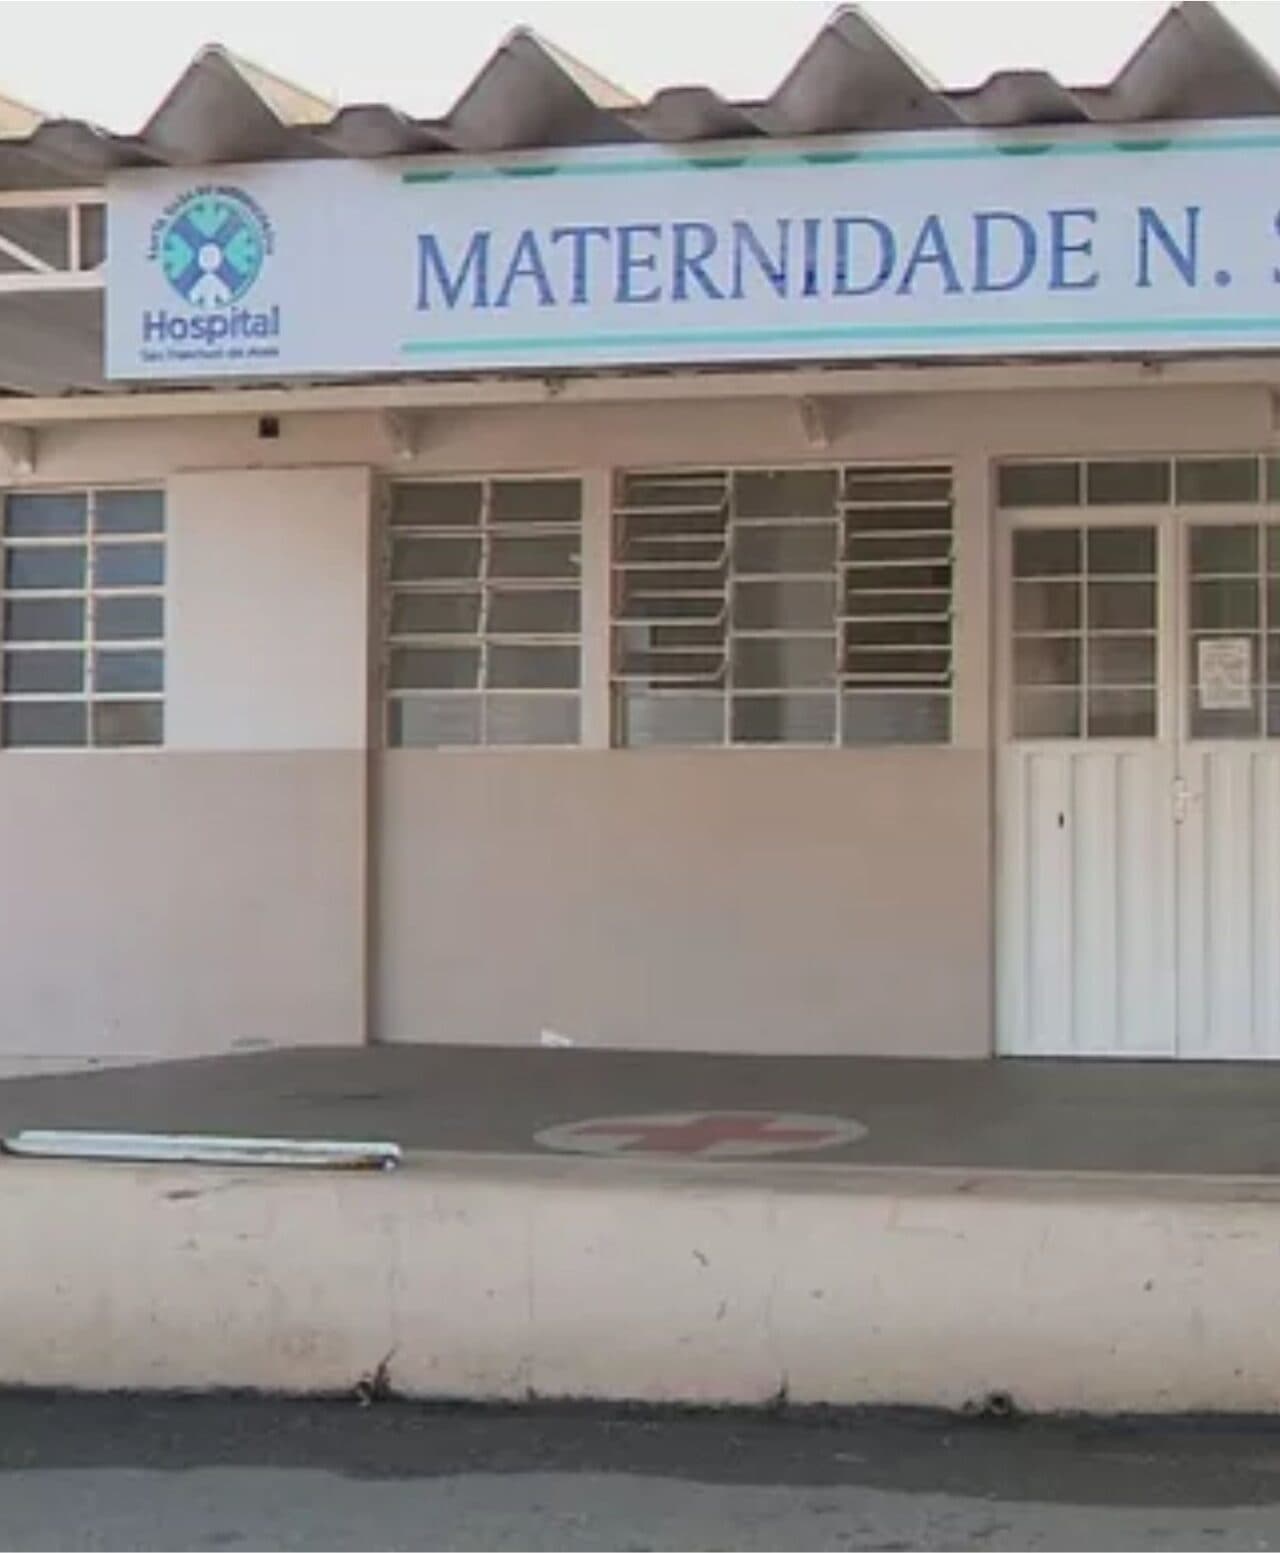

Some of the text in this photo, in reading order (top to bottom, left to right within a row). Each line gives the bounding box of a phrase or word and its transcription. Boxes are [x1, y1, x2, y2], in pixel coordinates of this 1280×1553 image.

[416, 209, 1099, 310] MATERNIDADE
[1135, 206, 1231, 287] N.
[143, 305, 280, 345] Hospital
